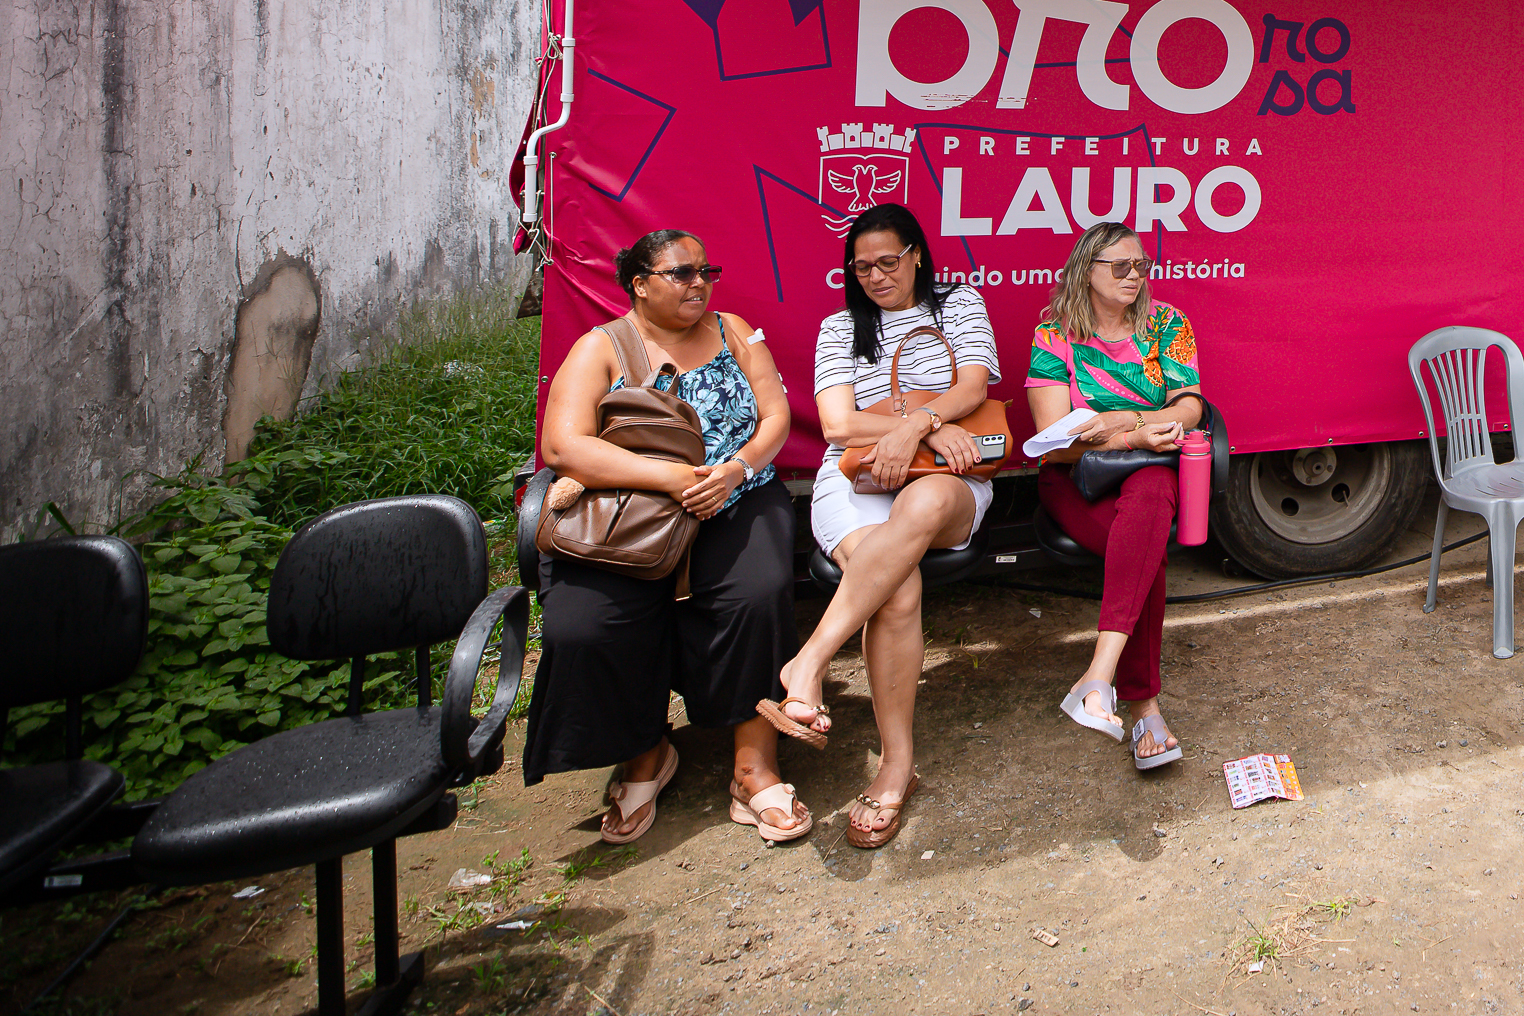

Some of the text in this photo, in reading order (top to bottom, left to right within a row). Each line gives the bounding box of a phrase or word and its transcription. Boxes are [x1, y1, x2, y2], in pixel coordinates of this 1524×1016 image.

[1258, 13, 1351, 64] ro
[1256, 68, 1357, 117] sa
[943, 136, 1263, 156] PREFEITURA
[940, 165, 1262, 237] LAURO
[1149, 258, 1246, 281] história
